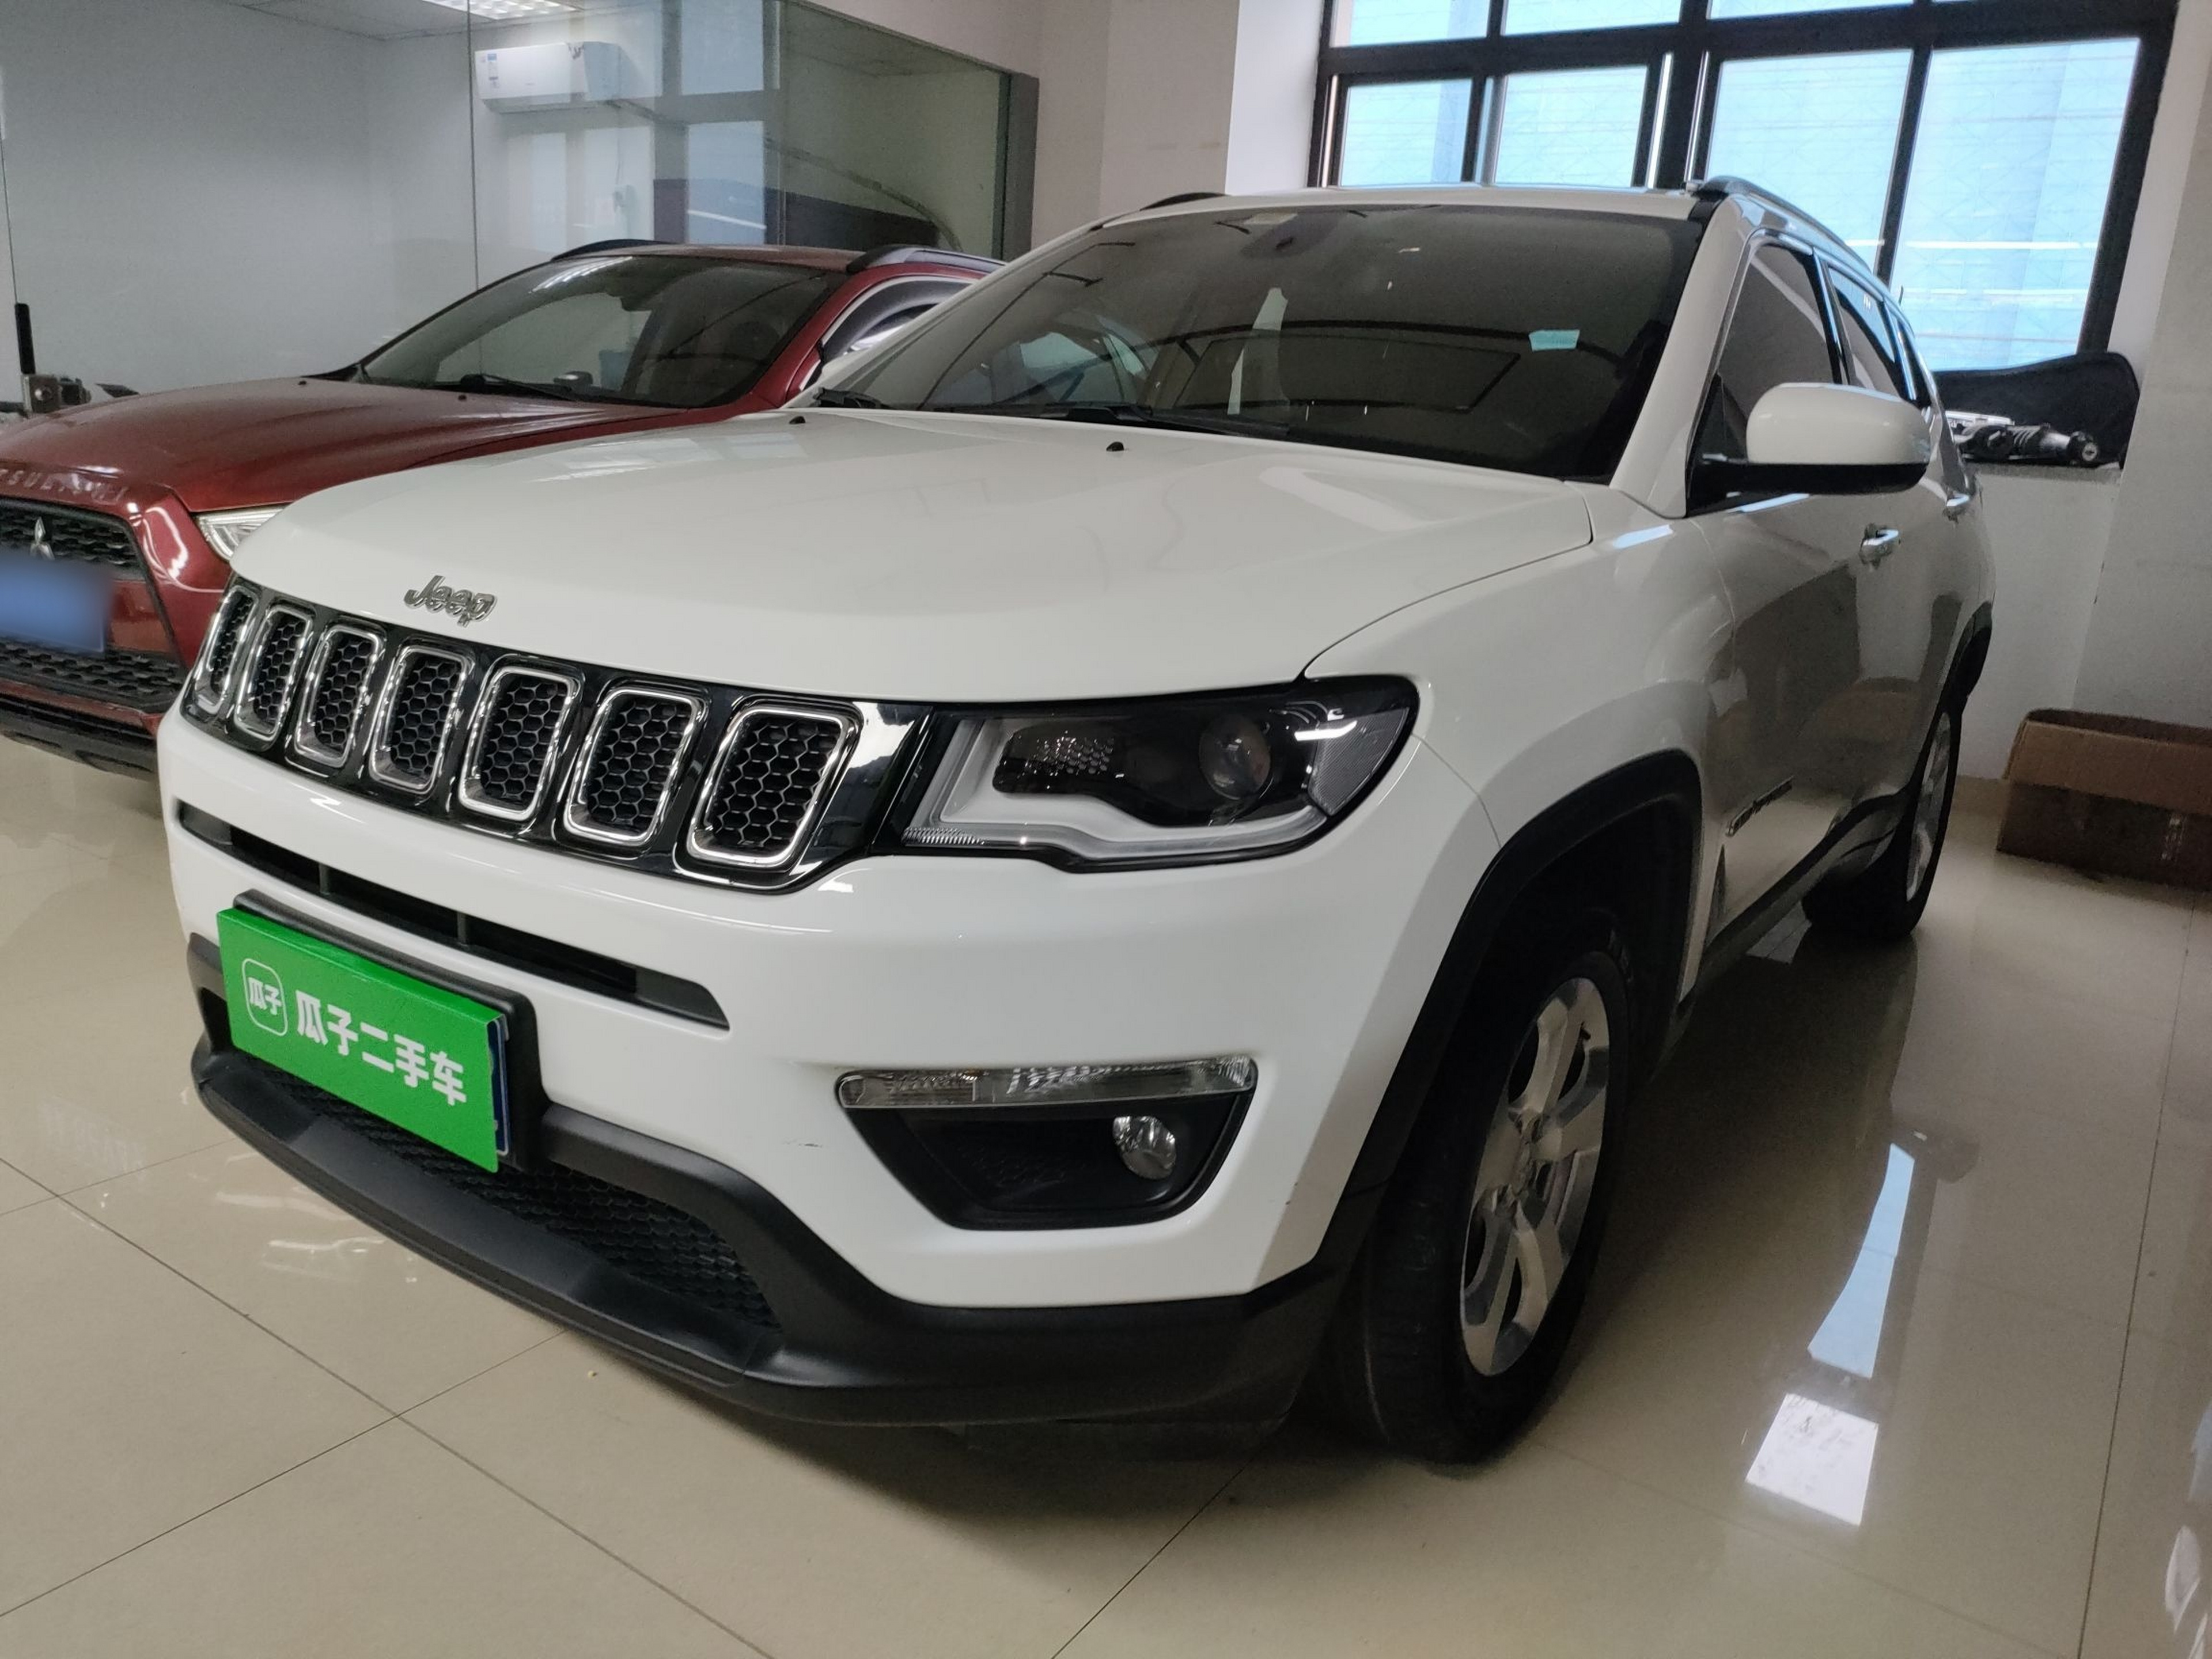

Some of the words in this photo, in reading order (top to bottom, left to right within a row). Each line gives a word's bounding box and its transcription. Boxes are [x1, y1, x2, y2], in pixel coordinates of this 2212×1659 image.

[404, 575, 497, 627] Jeep
[248, 977, 282, 1016] 瓜子
[296, 989, 467, 1106] 瓜子二手车
